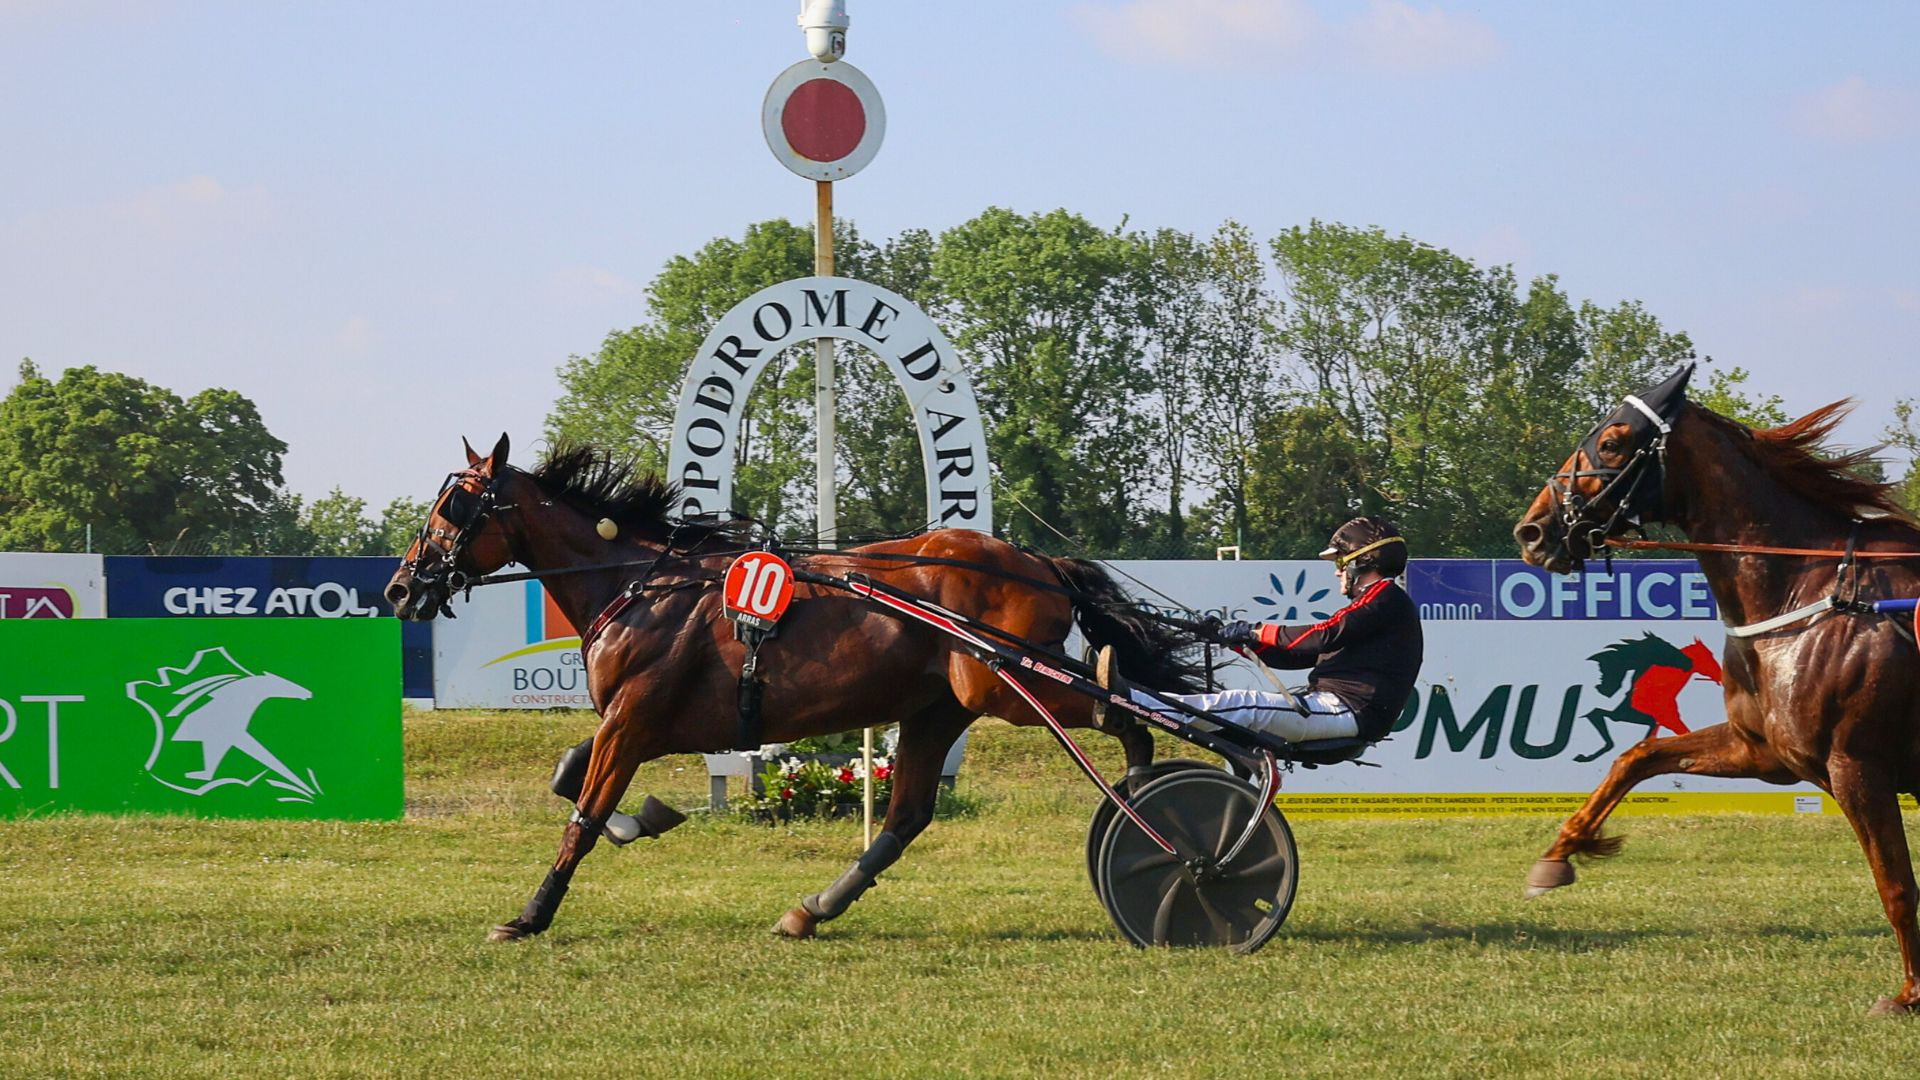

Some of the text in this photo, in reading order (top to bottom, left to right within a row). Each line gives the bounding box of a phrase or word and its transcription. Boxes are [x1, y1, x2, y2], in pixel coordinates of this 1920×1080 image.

[164, 582, 380, 619] CHEZ ATOL,
[736, 557, 786, 615] 10
[1500, 571, 1708, 618] OFFICE
[736, 613, 761, 627] ARRAS
[512, 694, 592, 705] CONSTRUCT
